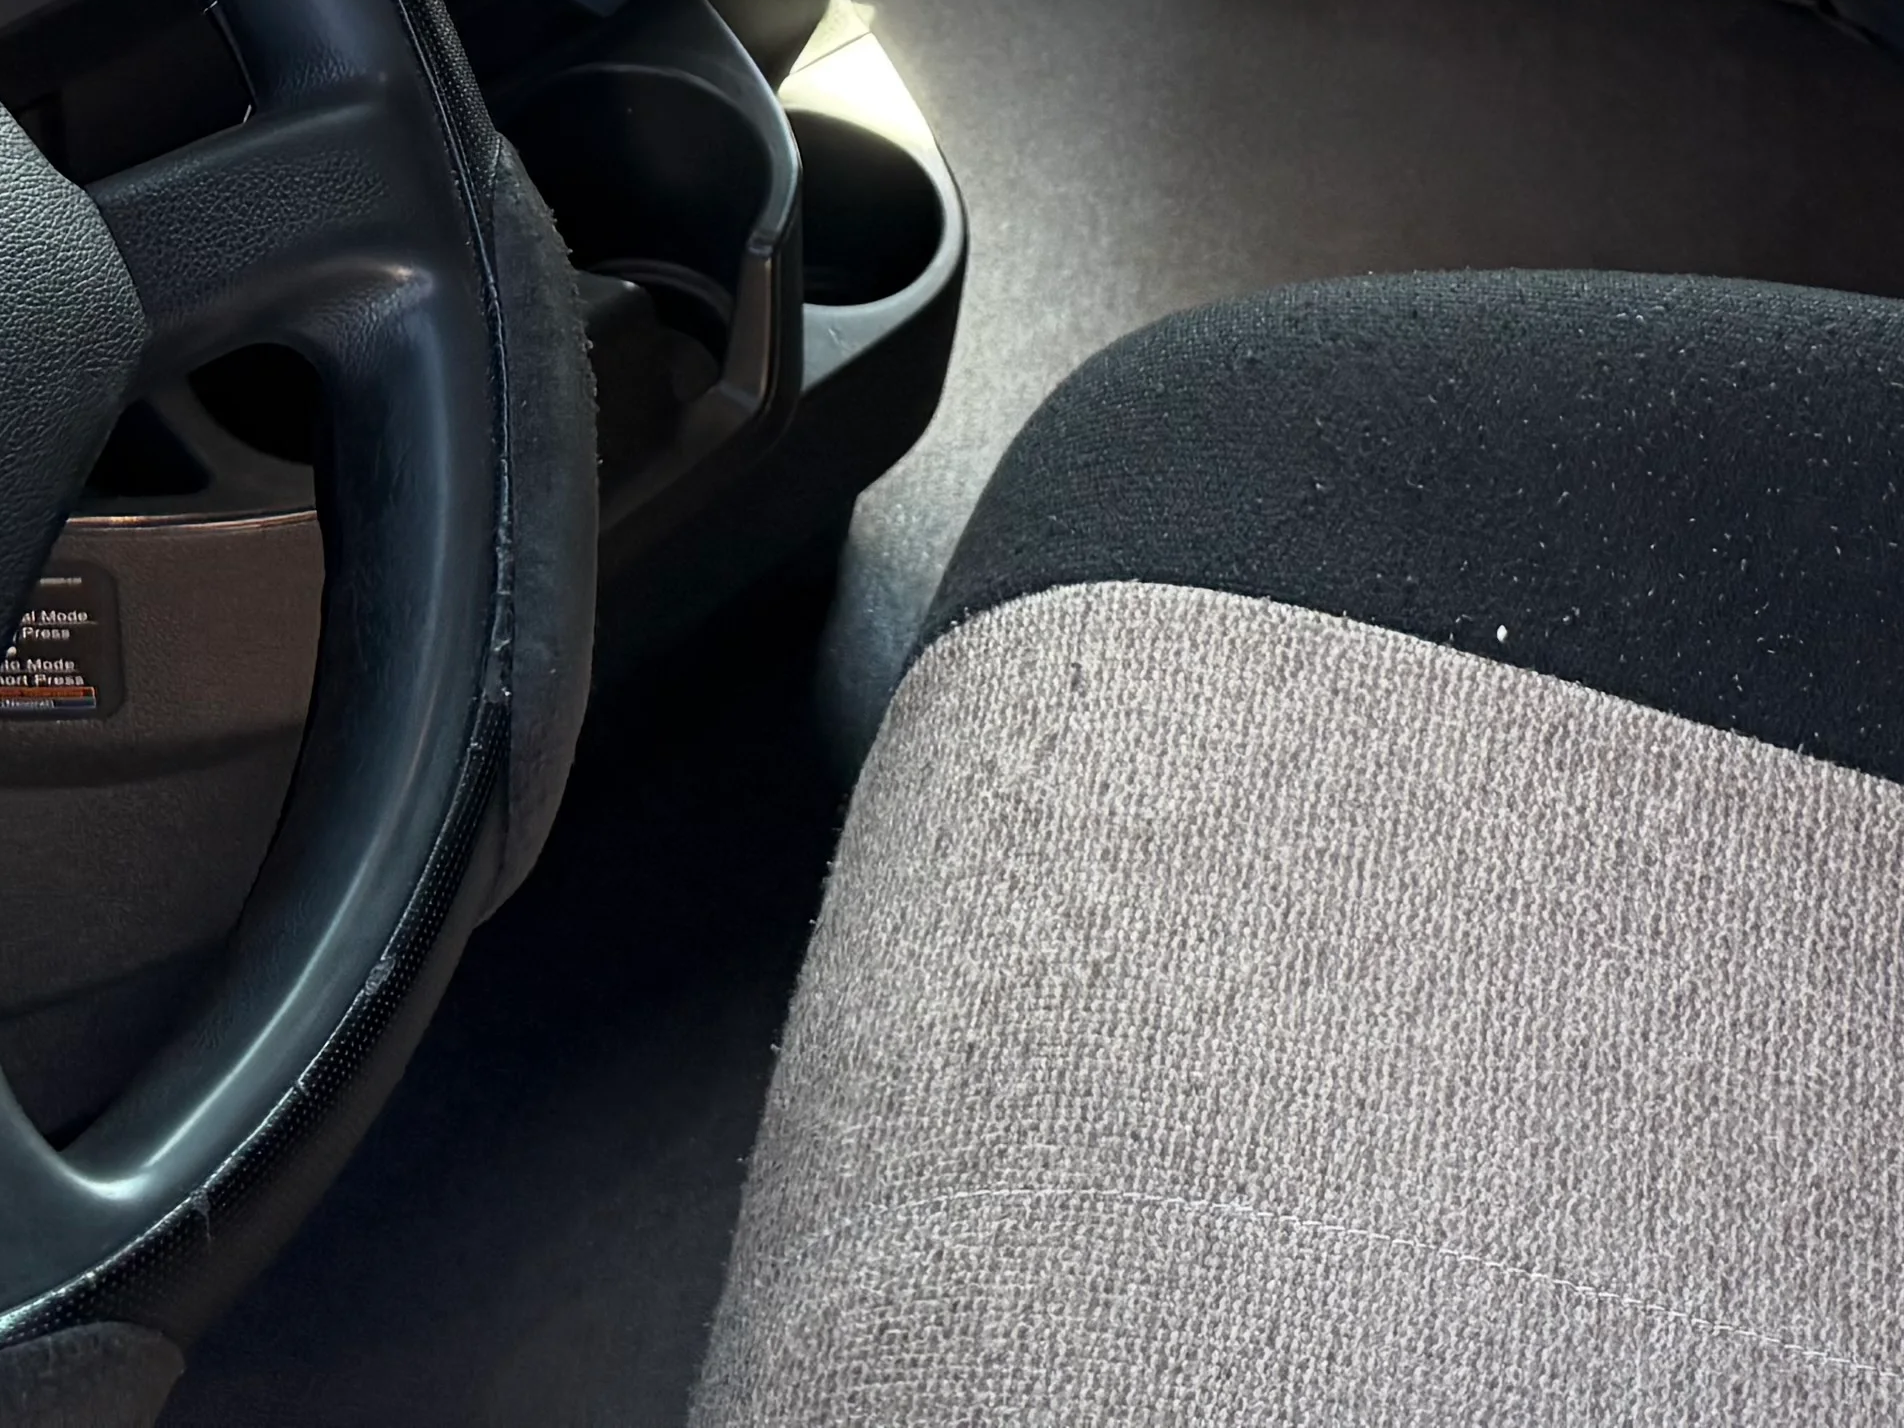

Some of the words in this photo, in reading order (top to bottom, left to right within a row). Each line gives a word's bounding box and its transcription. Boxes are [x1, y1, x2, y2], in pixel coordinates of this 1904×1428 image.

[40, 609, 88, 624] Mode
[22, 626, 71, 641] Press
[26, 657, 76, 672] Mode
[33, 673, 85, 688] Press
